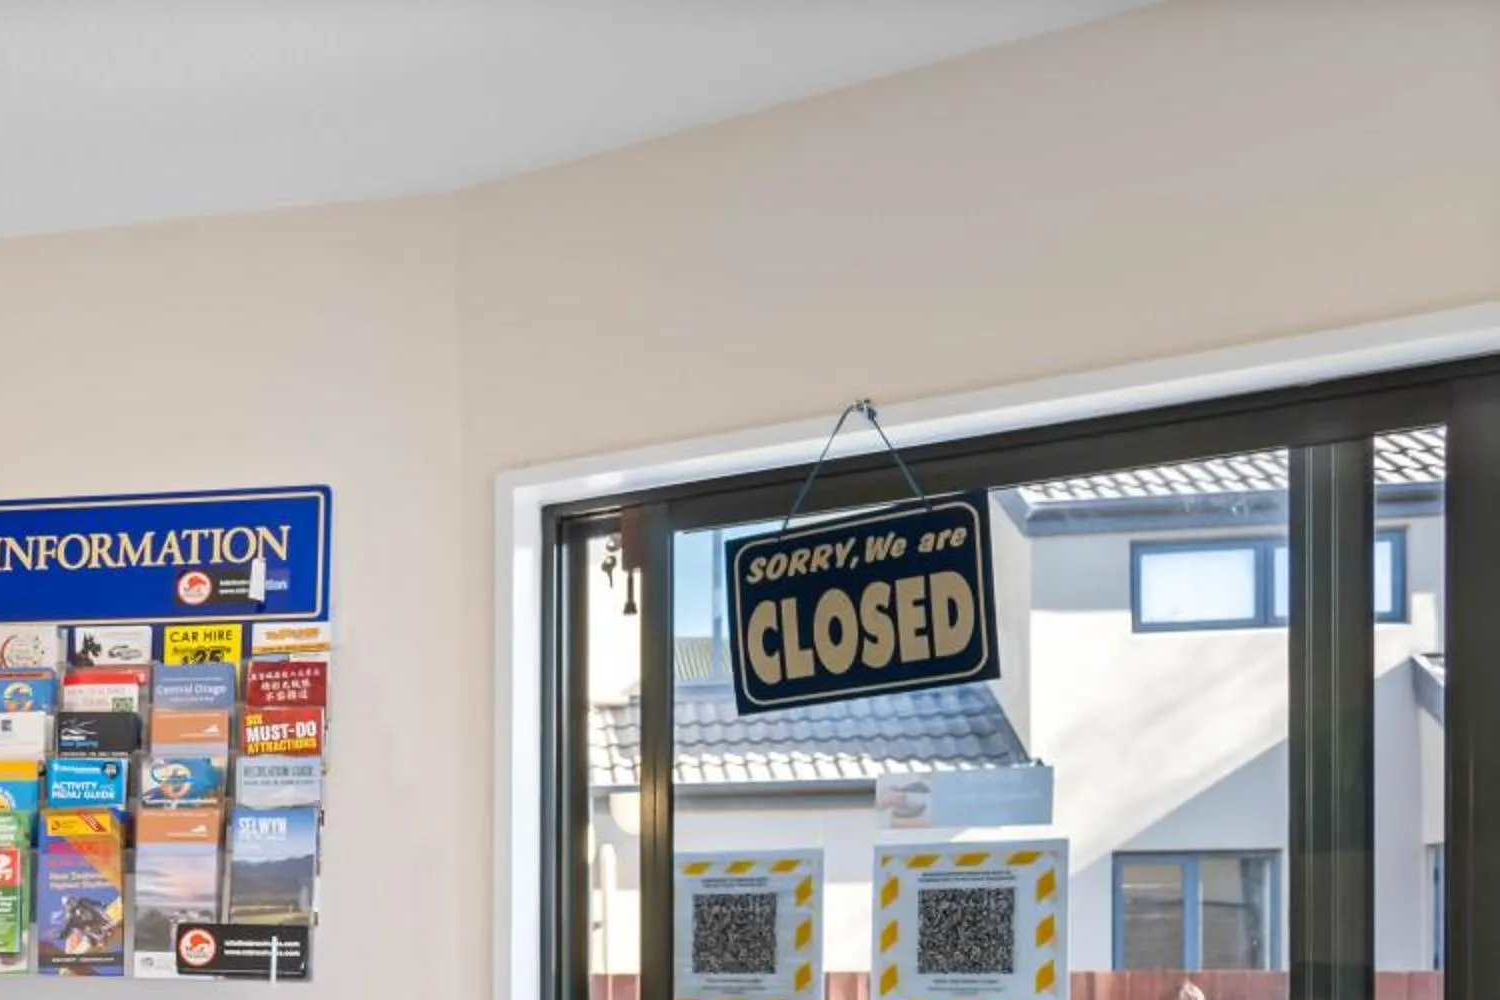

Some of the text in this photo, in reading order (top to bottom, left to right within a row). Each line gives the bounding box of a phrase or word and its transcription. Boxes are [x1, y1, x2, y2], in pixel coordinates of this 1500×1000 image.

[746, 527, 967, 585] SORRY, We are
[169, 629, 233, 643] CAR HIRE
[747, 571, 975, 685] CLOSED
[246, 721, 317, 742] MUST-DO
[52, 781, 98, 792] ACTIVITY
[83, 790, 115, 800] GUIDE
[238, 817, 287, 835] SELWYN
